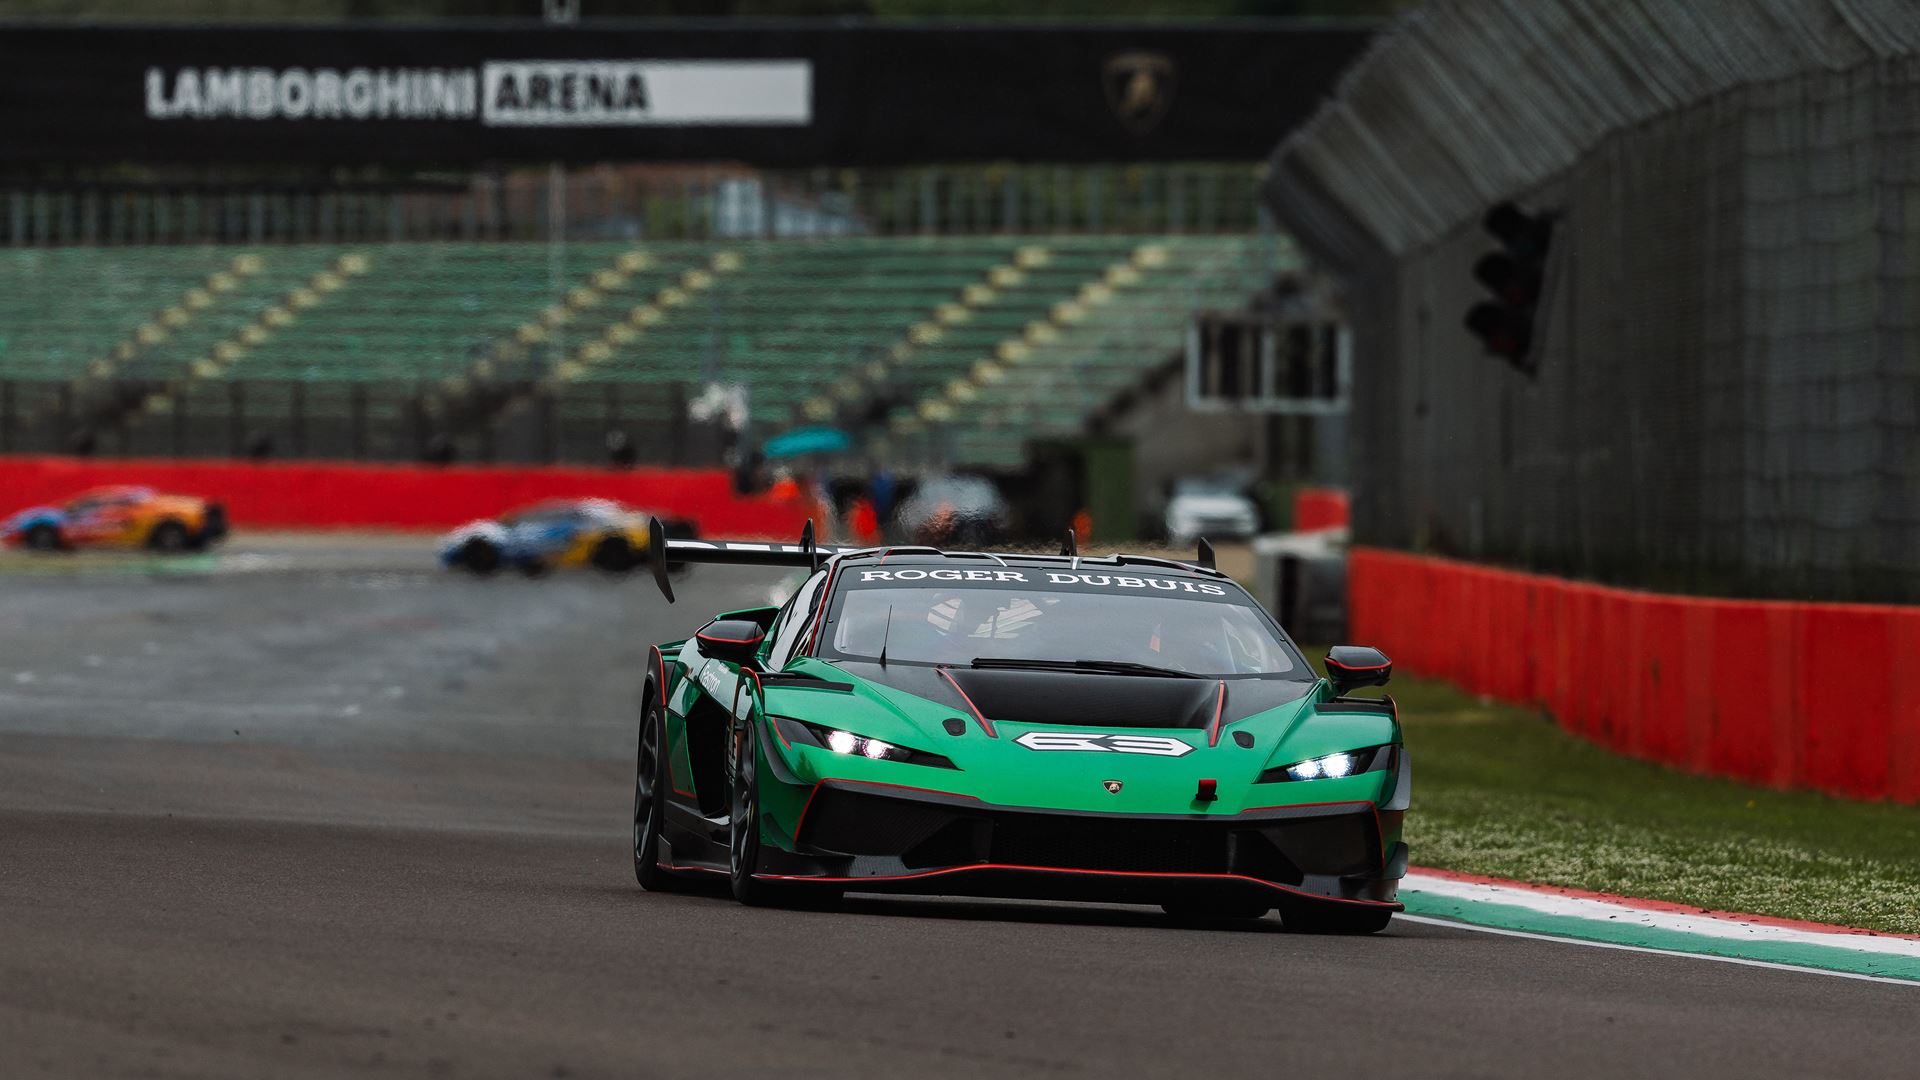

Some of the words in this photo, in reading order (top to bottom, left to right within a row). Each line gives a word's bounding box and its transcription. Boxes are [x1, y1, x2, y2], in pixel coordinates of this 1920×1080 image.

[146, 67, 476, 118] LAMBORGHINI
[495, 72, 648, 113] ARENA
[860, 568, 1028, 583] ROGER
[1046, 572, 1226, 597] DUBUIS
[1015, 732, 1195, 757] 63
